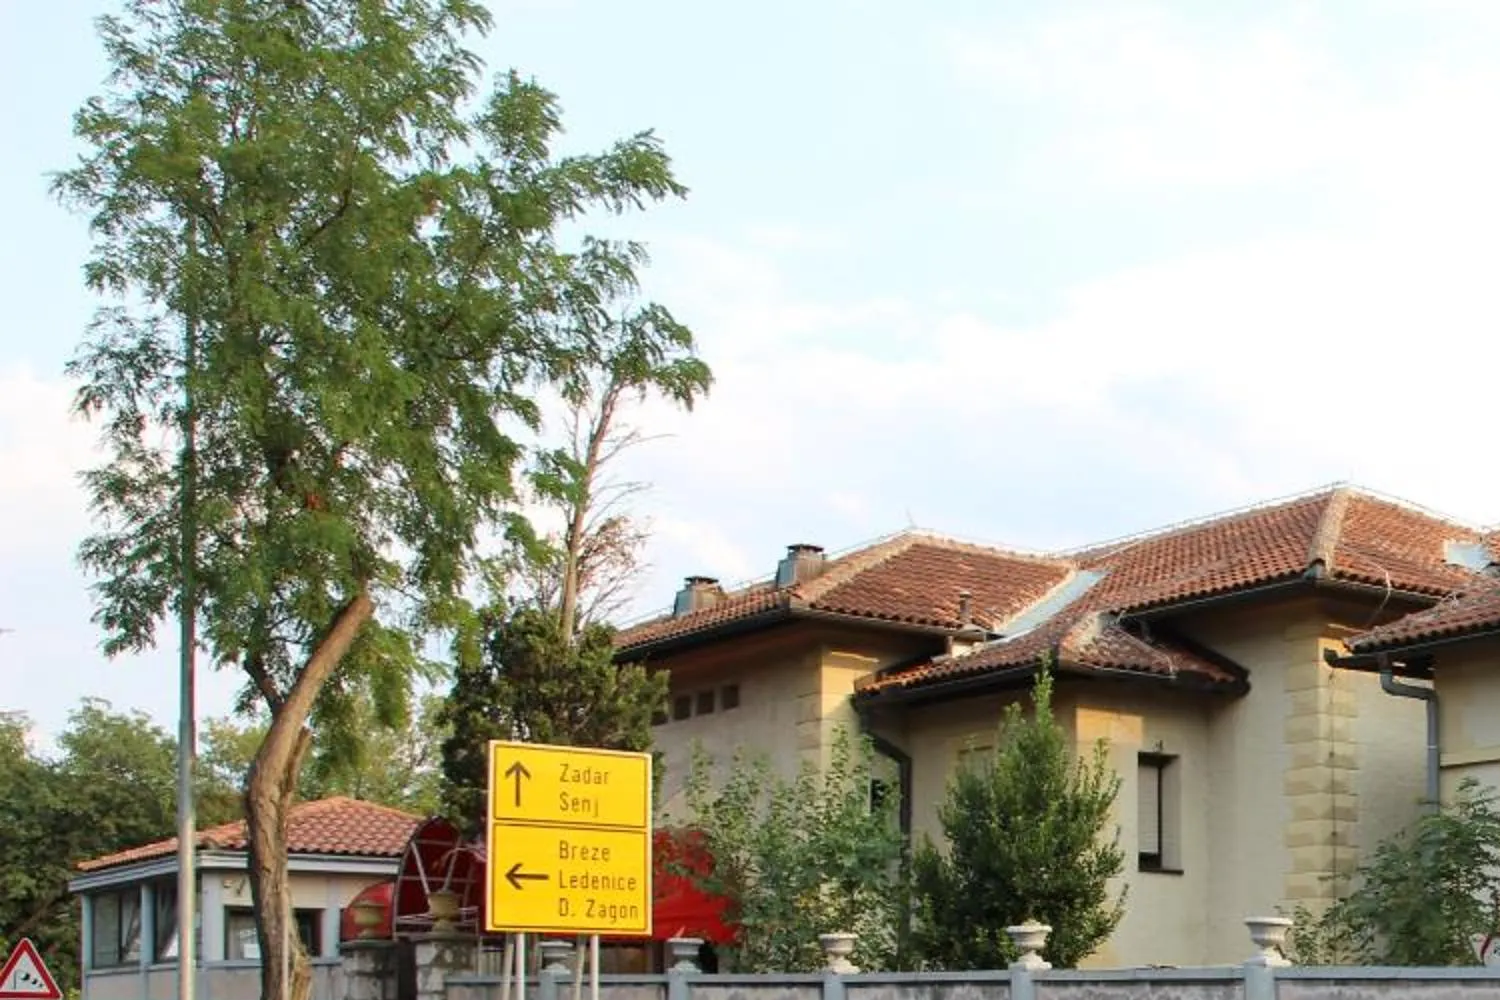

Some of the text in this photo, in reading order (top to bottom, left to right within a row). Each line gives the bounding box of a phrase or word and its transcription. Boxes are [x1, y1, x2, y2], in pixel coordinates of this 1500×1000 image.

[559, 763, 609, 785] Zadar
[559, 791, 599, 817] Senj
[559, 840, 611, 861] Breze
[559, 869, 637, 891] Ledenice
[558, 898, 639, 923] D. Zagon
